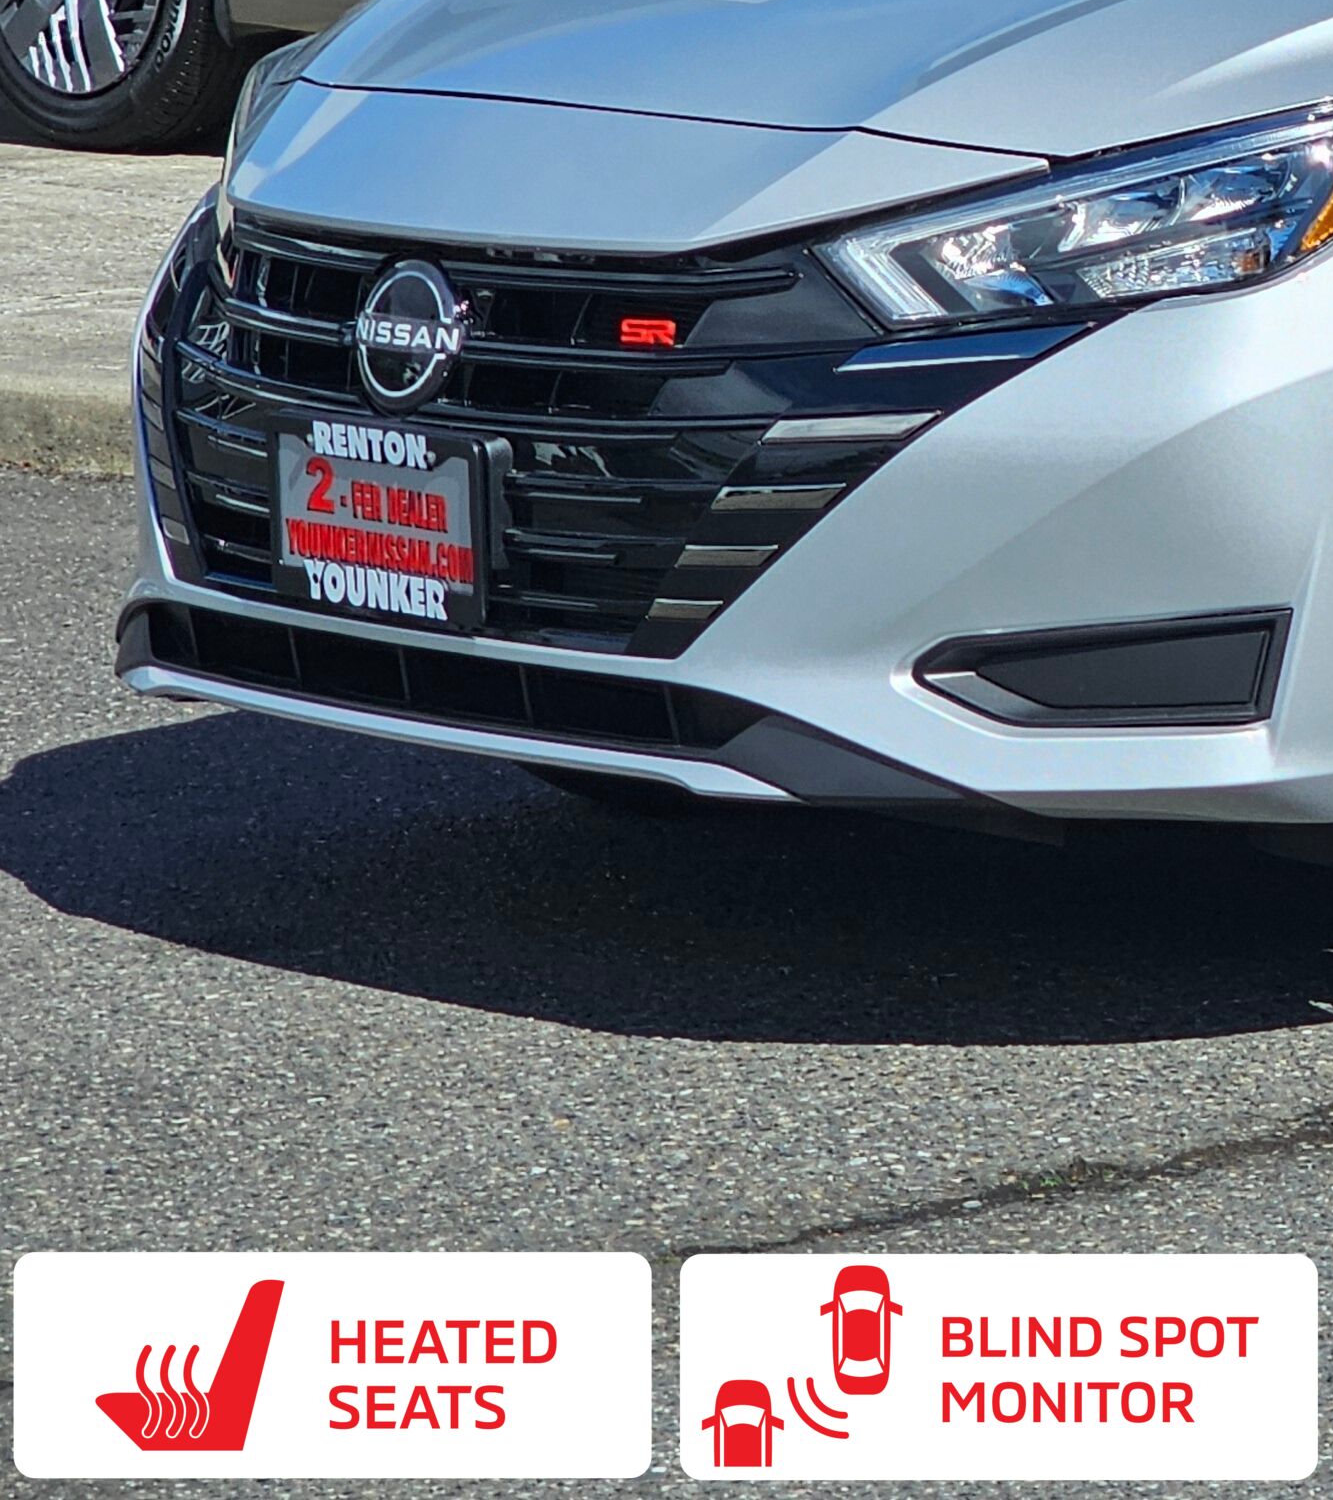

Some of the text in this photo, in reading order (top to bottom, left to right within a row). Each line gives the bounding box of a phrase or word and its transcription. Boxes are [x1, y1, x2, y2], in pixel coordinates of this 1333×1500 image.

[356, 319, 460, 351] NISSAN
[620, 317, 677, 347] SR
[312, 420, 428, 470] RENTON
[387, 486, 448, 534] DEALER
[286, 518, 474, 585] YOUNKERNISSAN.COM
[303, 559, 448, 621] YOUNKER
